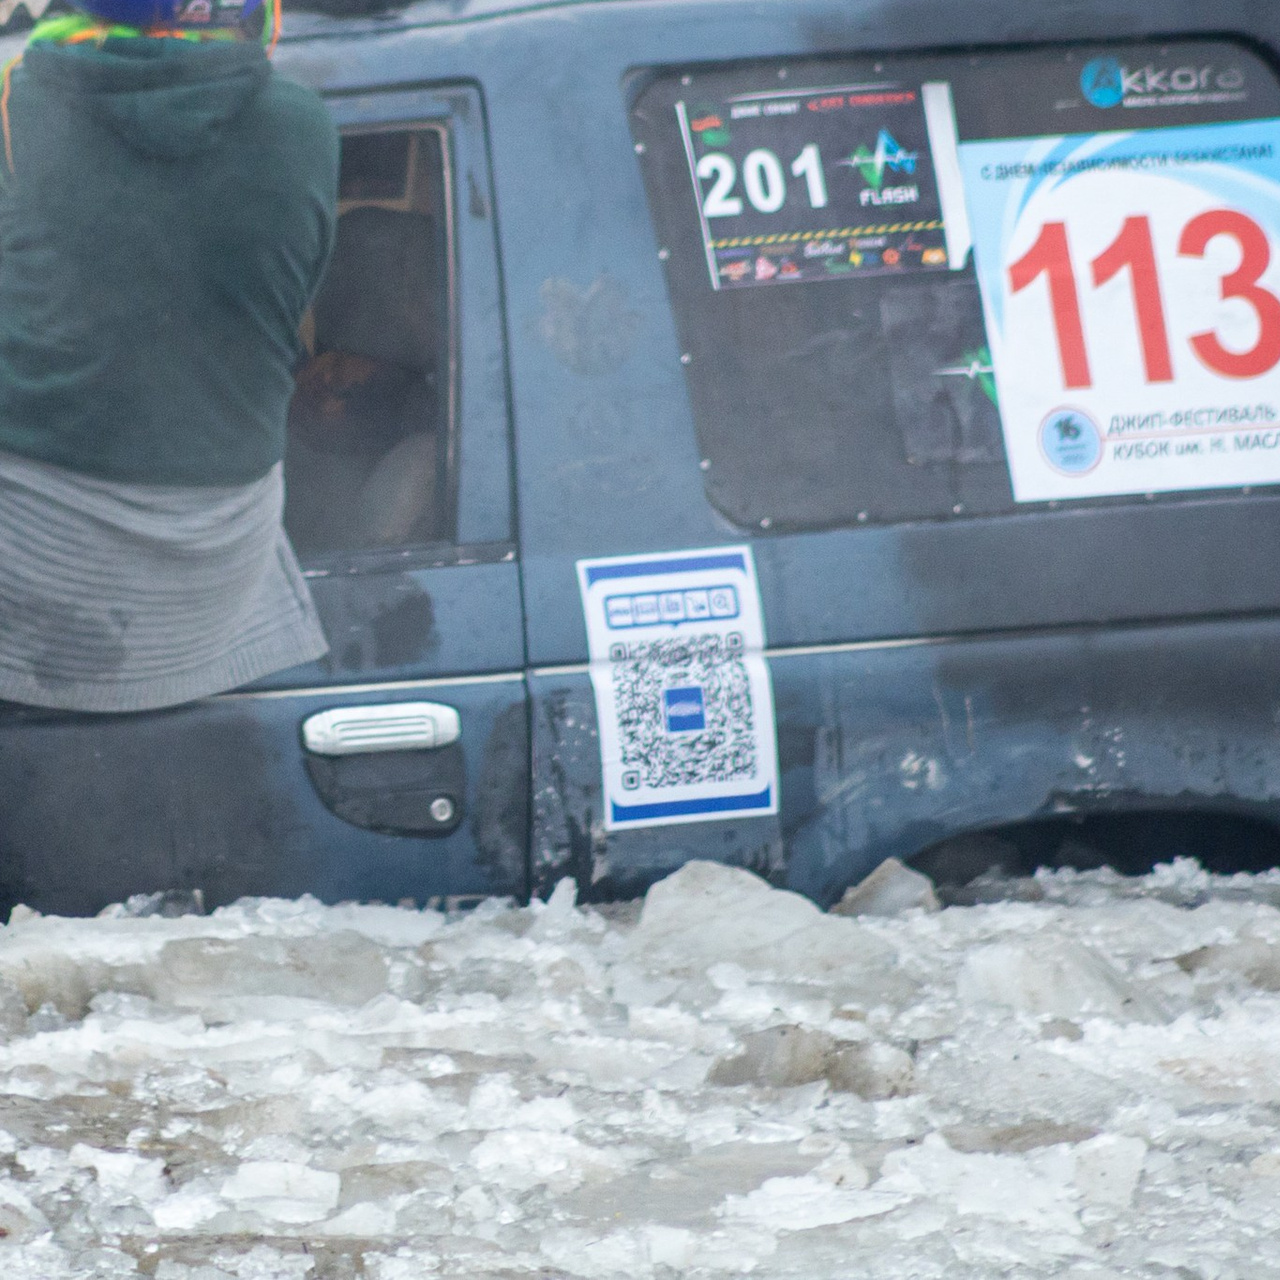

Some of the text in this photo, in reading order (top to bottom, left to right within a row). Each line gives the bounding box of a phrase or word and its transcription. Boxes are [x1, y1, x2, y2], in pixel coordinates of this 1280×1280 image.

[696, 144, 827, 218] 201
[859, 185, 919, 207] FLASH
[1008, 209, 1280, 390] 113
[1112, 439, 1169, 461] КУБОК
